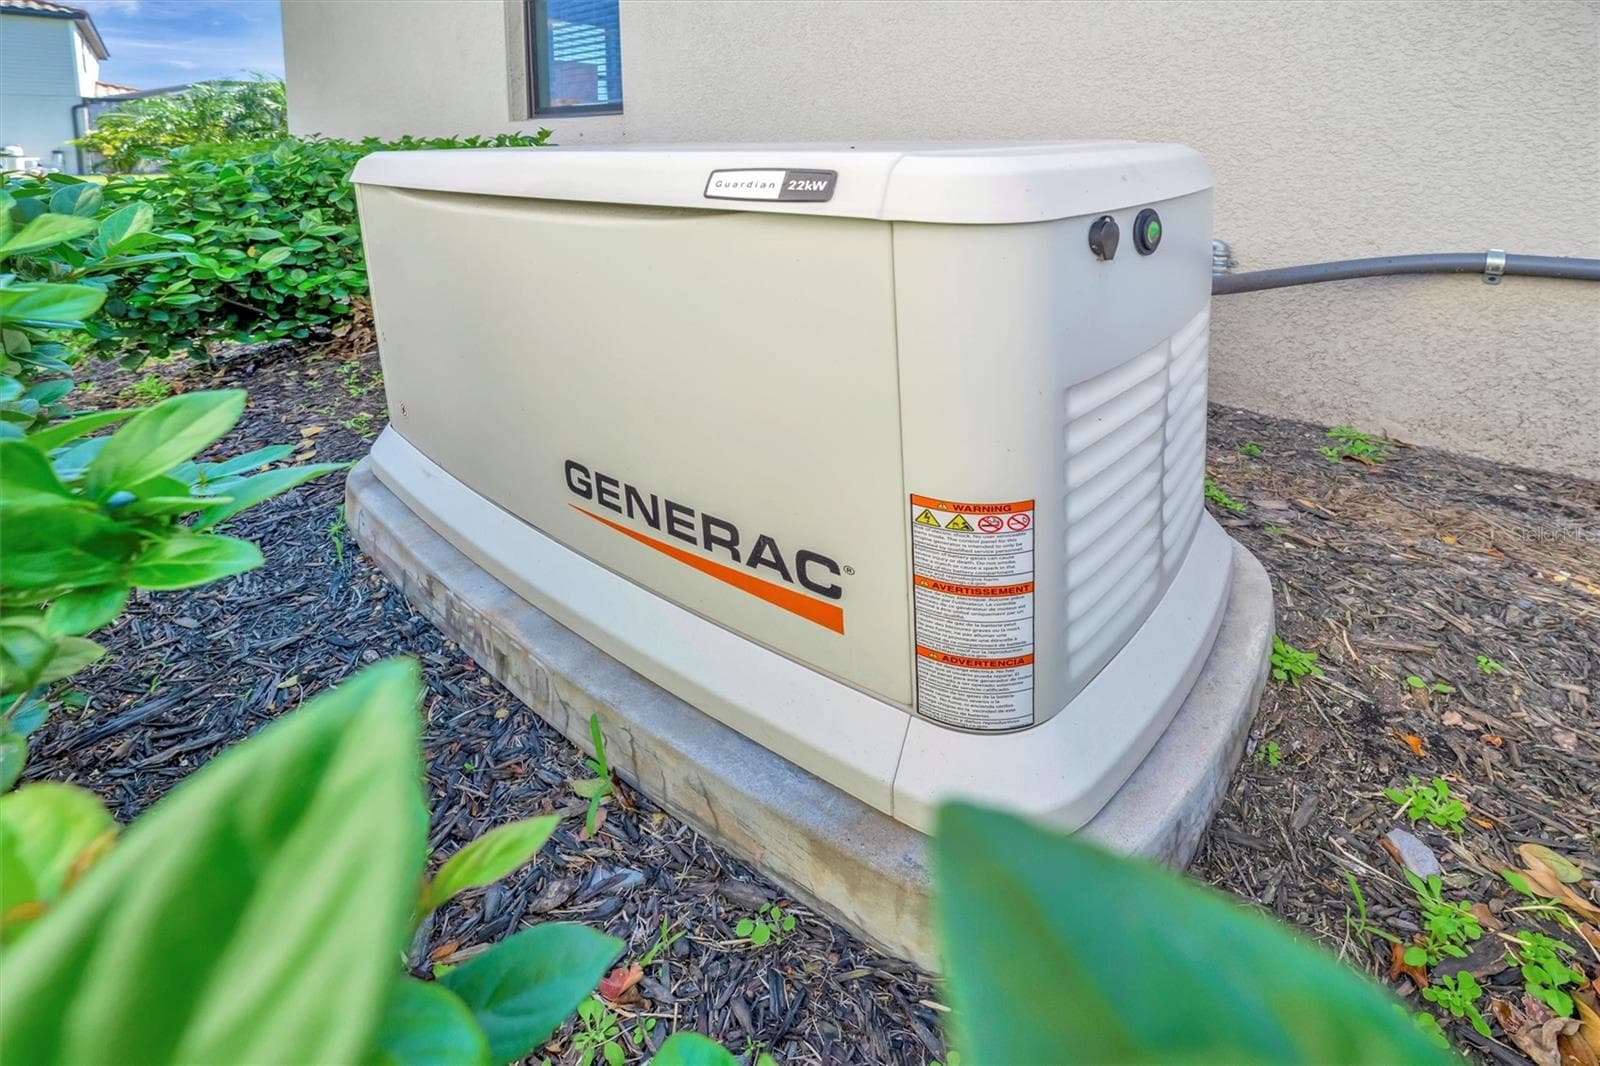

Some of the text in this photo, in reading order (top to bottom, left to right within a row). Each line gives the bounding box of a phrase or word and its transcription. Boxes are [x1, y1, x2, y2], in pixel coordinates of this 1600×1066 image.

[715, 180, 828, 192] Guardian 22kW
[952, 504, 1012, 513] WARNING
[932, 582, 1030, 595] AVERTISSEMENT
[942, 656, 1025, 667] ADVERTENCIA
